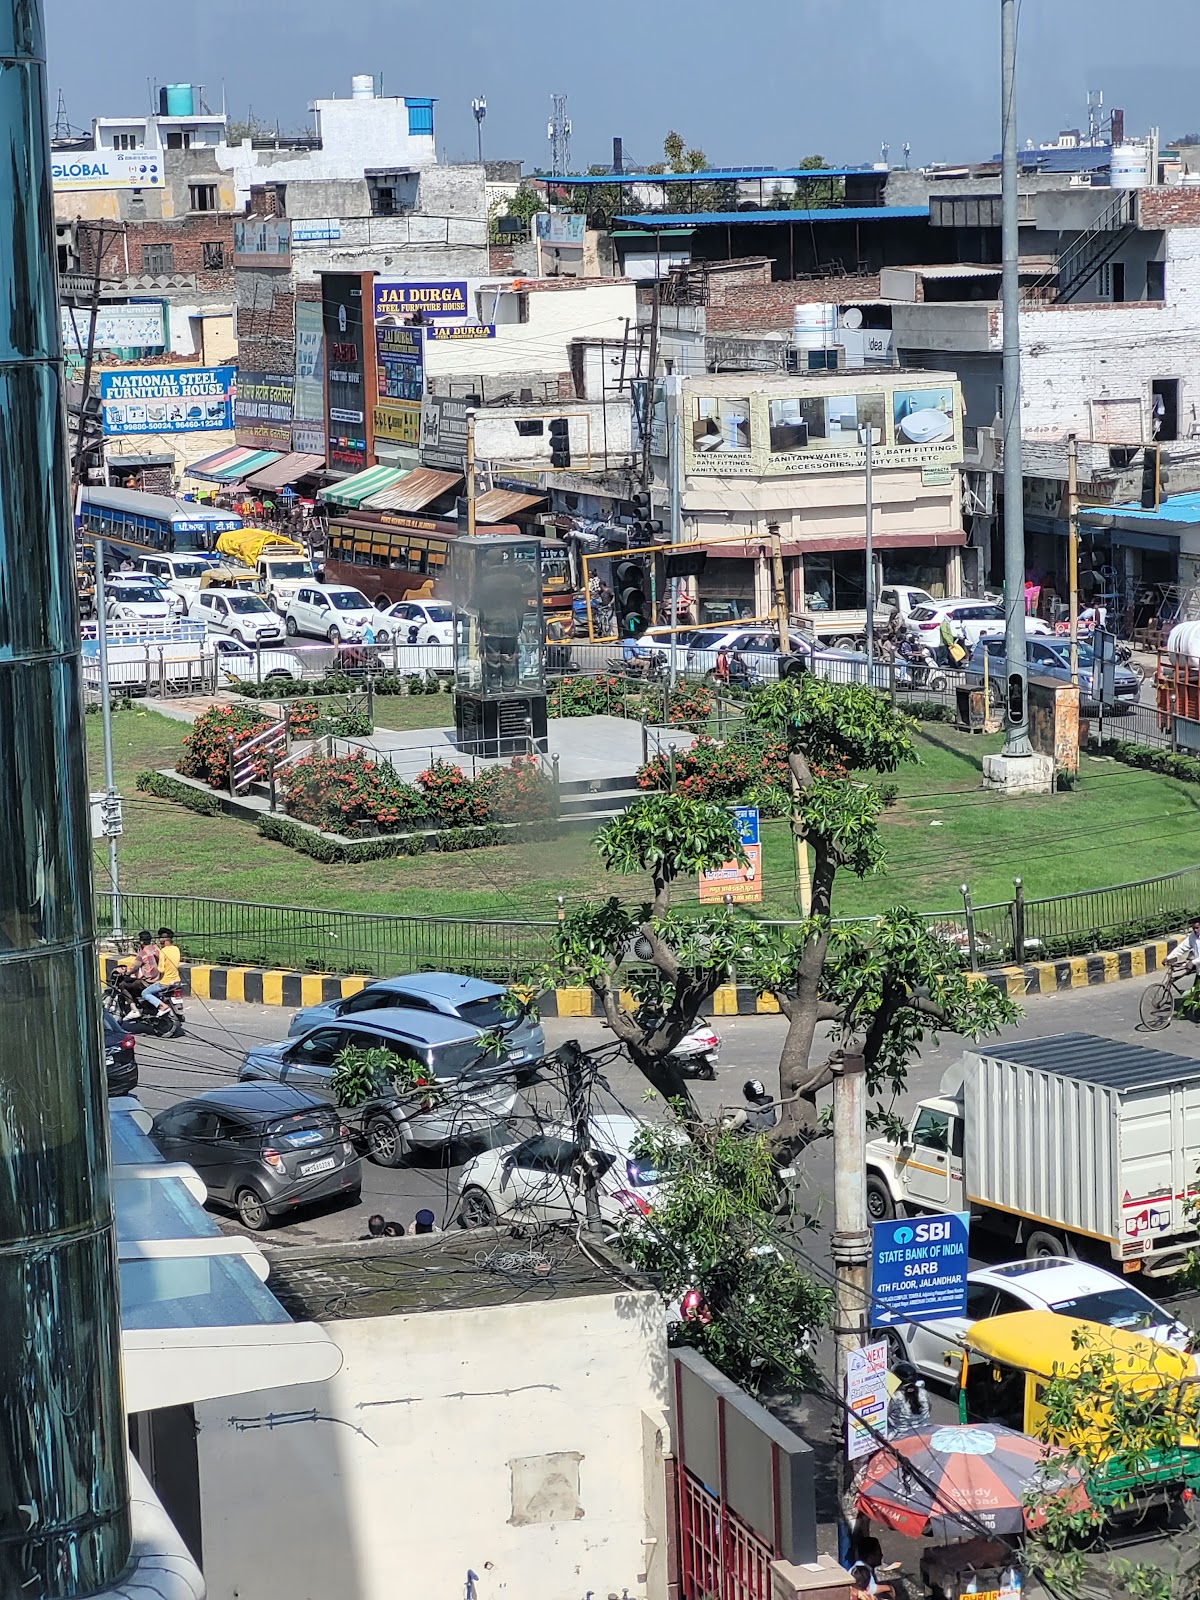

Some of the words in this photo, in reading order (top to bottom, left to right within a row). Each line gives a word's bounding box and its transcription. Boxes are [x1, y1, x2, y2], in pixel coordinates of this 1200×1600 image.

[52, 164, 109, 177] GLOBAL
[380, 290, 405, 302] JAI
[409, 288, 462, 302] DURGA
[121, 306, 160, 314] Furniture
[377, 304, 399, 312] STEEL
[401, 303, 441, 312] FURNITURE
[442, 302, 466, 310] HOUSE
[384, 330, 394, 342] JAI
[394, 330, 413, 344] DURGA
[453, 327, 491, 335] DURGA
[112, 374, 177, 387] NATIONAL
[179, 373, 217, 384] STEEL
[106, 386, 180, 399] FURNITURE
[182, 383, 224, 395] HOUSE
[270, 404, 292, 421] FURNITURE
[768, 452, 851, 462] SANITARYWARES,
[914, 445, 958, 453] FITTINGS
[1076, 483, 1112, 498] OPULAR
[915, 1222, 950, 1242] SBI
[879, 1250, 904, 1264] STATE
[905, 1247, 928, 1260] BANK
[930, 1245, 941, 1257] OF
[942, 1243, 964, 1256] INDIA
[904, 1262, 938, 1276] SARB
[877, 1284, 890, 1292] 4TH
[892, 1280, 918, 1291] FLOOR,
[919, 1275, 963, 1287] JALANDHAR.
[867, 1347, 884, 1363] NEXT
[867, 1361, 885, 1373] DIAMOND
[851, 1386, 865, 1399] Staff
[865, 1378, 886, 1396] Required
[952, 1488, 991, 1498] Study
[959, 1497, 998, 1505] broad
[871, 1503, 900, 1522] CANAM
